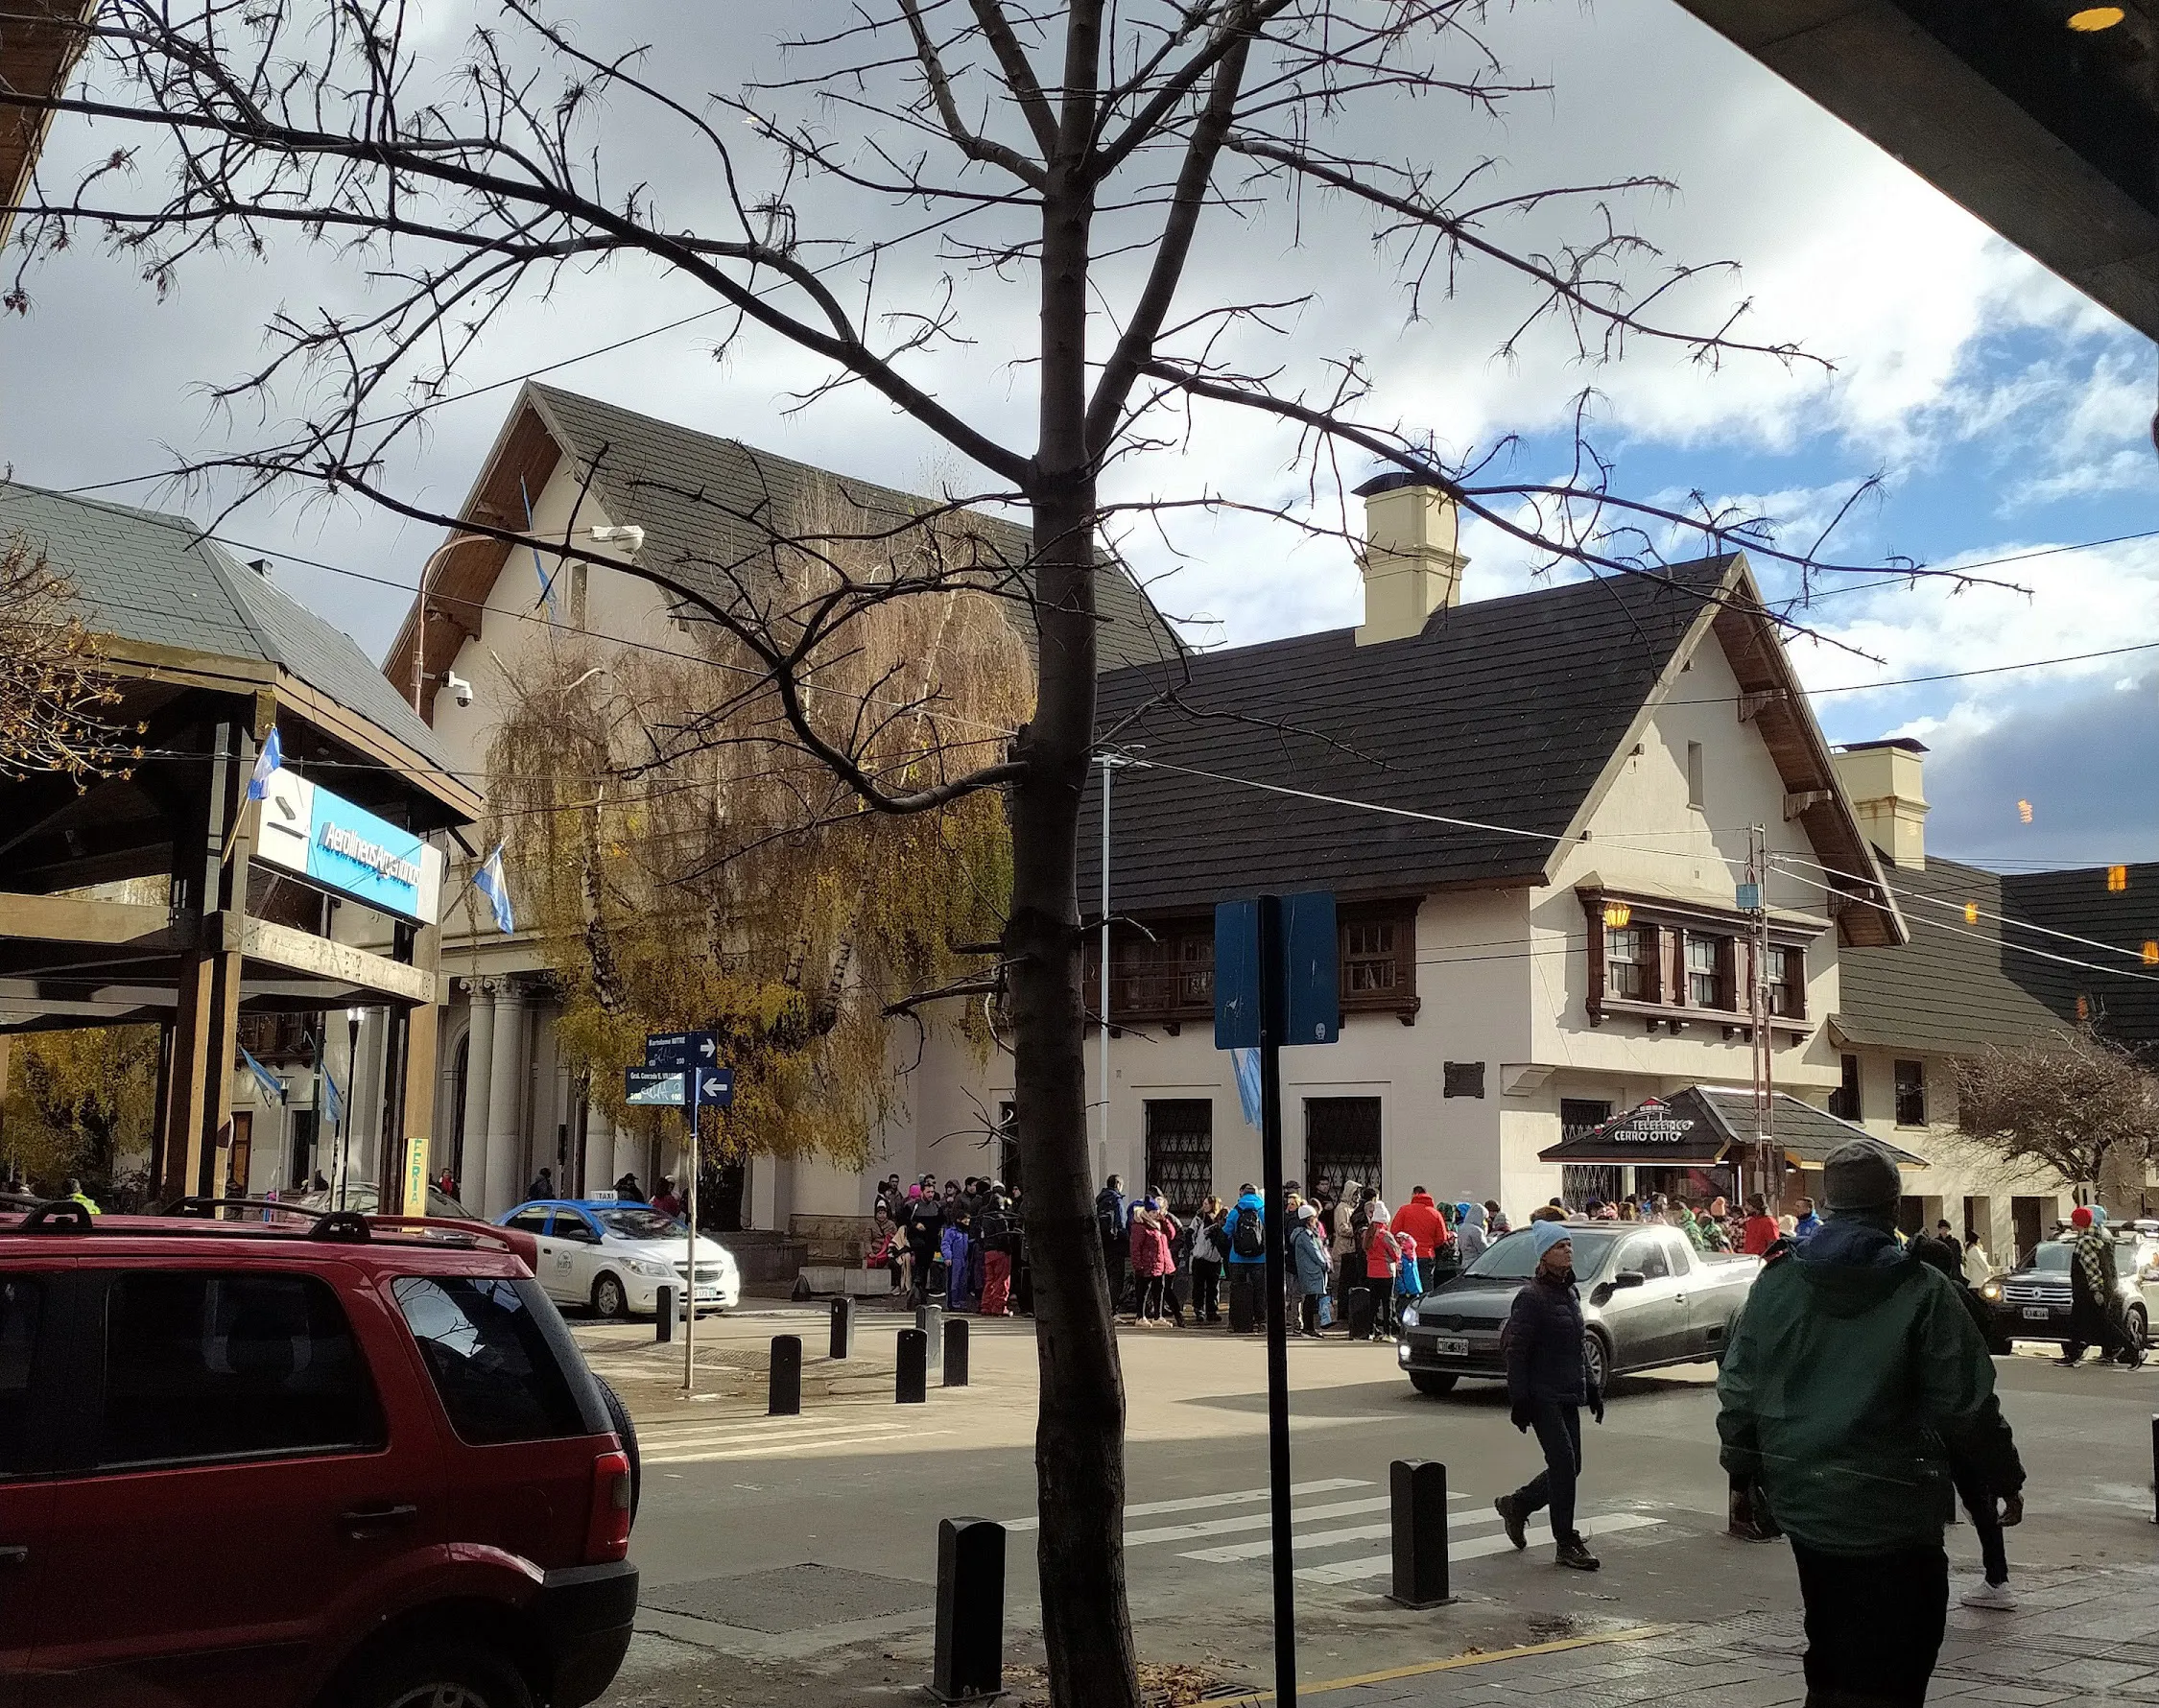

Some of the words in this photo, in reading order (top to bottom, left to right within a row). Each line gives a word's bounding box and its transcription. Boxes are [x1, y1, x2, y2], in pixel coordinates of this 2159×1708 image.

[1614, 1130, 1648, 1142] CERRO
[1649, 1130, 1680, 1142] OTTO
[412, 1138, 422, 1203] FERIA
